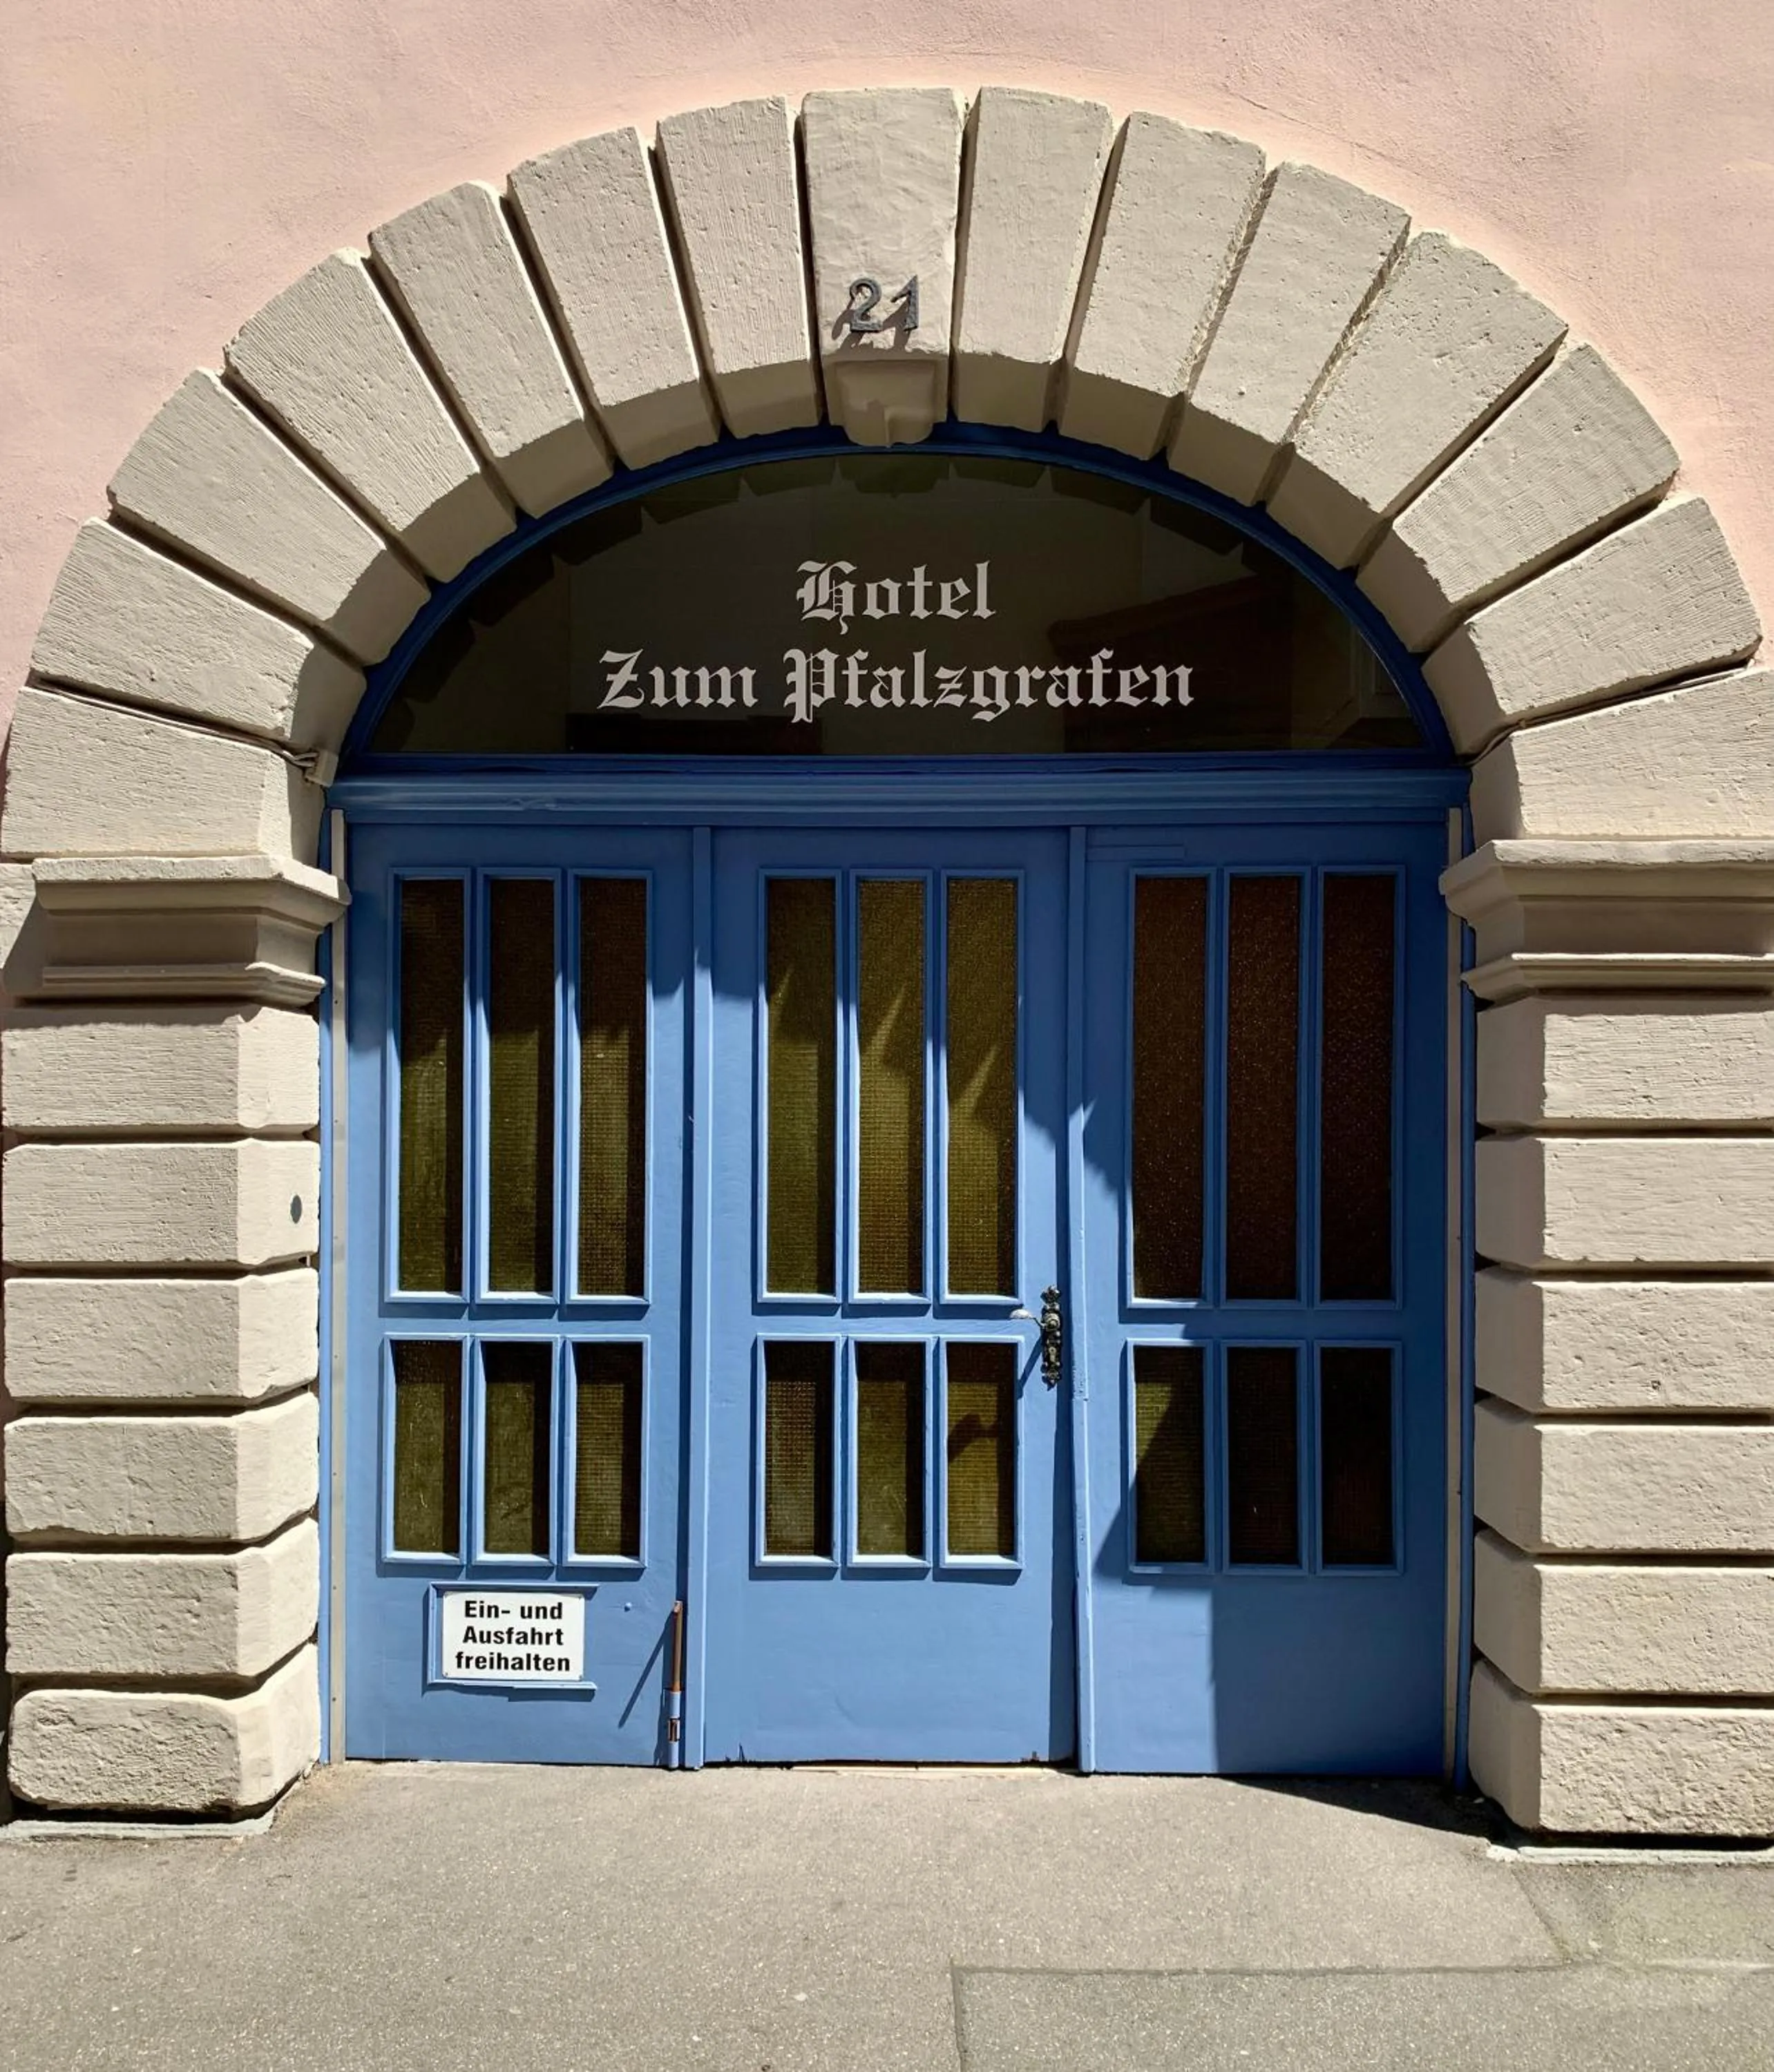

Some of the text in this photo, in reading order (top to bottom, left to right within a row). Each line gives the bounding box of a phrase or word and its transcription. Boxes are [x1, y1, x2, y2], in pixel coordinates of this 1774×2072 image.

[849, 274, 919, 333] 21
[796, 560, 996, 635] Hotel
[598, 647, 1195, 724] Zum Pfalzgrafen
[464, 1600, 563, 1620] Ein- und
[462, 1625, 564, 1647] Ausfahrt
[455, 1651, 571, 1672] freihalten
